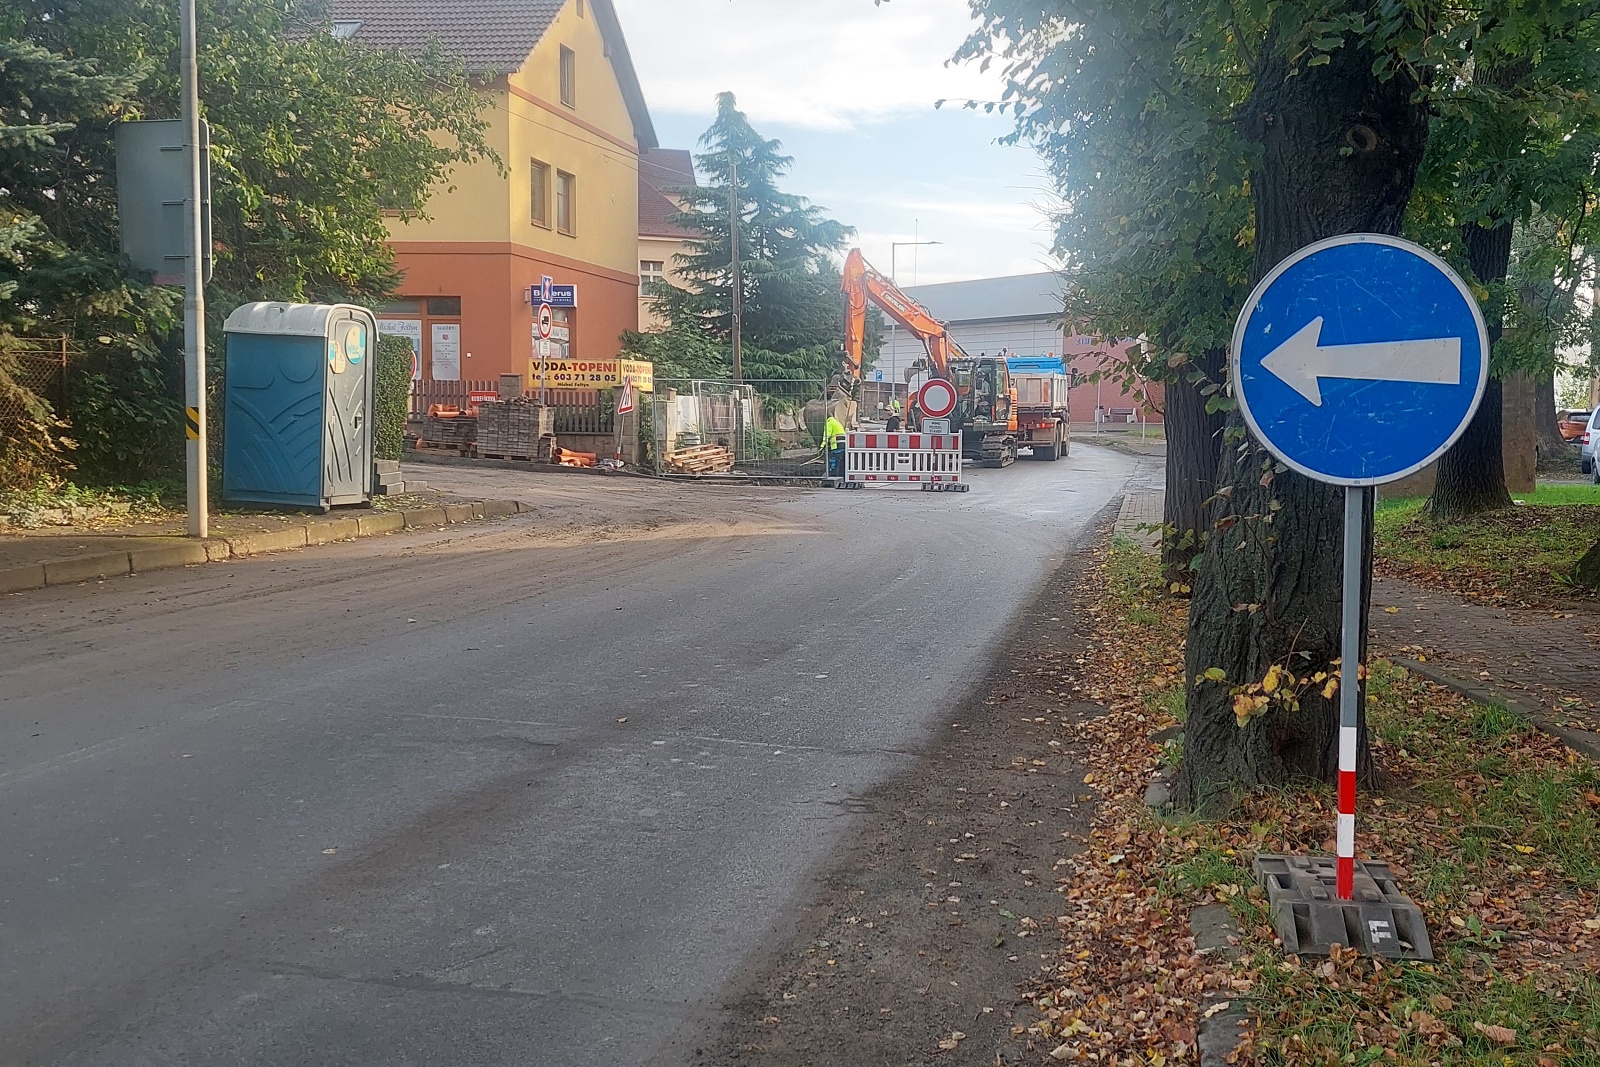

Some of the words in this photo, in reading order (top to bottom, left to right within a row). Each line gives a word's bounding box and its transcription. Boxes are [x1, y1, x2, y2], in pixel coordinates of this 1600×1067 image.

[533, 289, 572, 297] Berus
[532, 360, 617, 373] VODA-TOPENÍ
[532, 373, 551, 381] te.:
[553, 373, 572, 381] 603
[574, 373, 585, 381] 71
[589, 374, 602, 382] 28
[604, 374, 617, 382] 05
